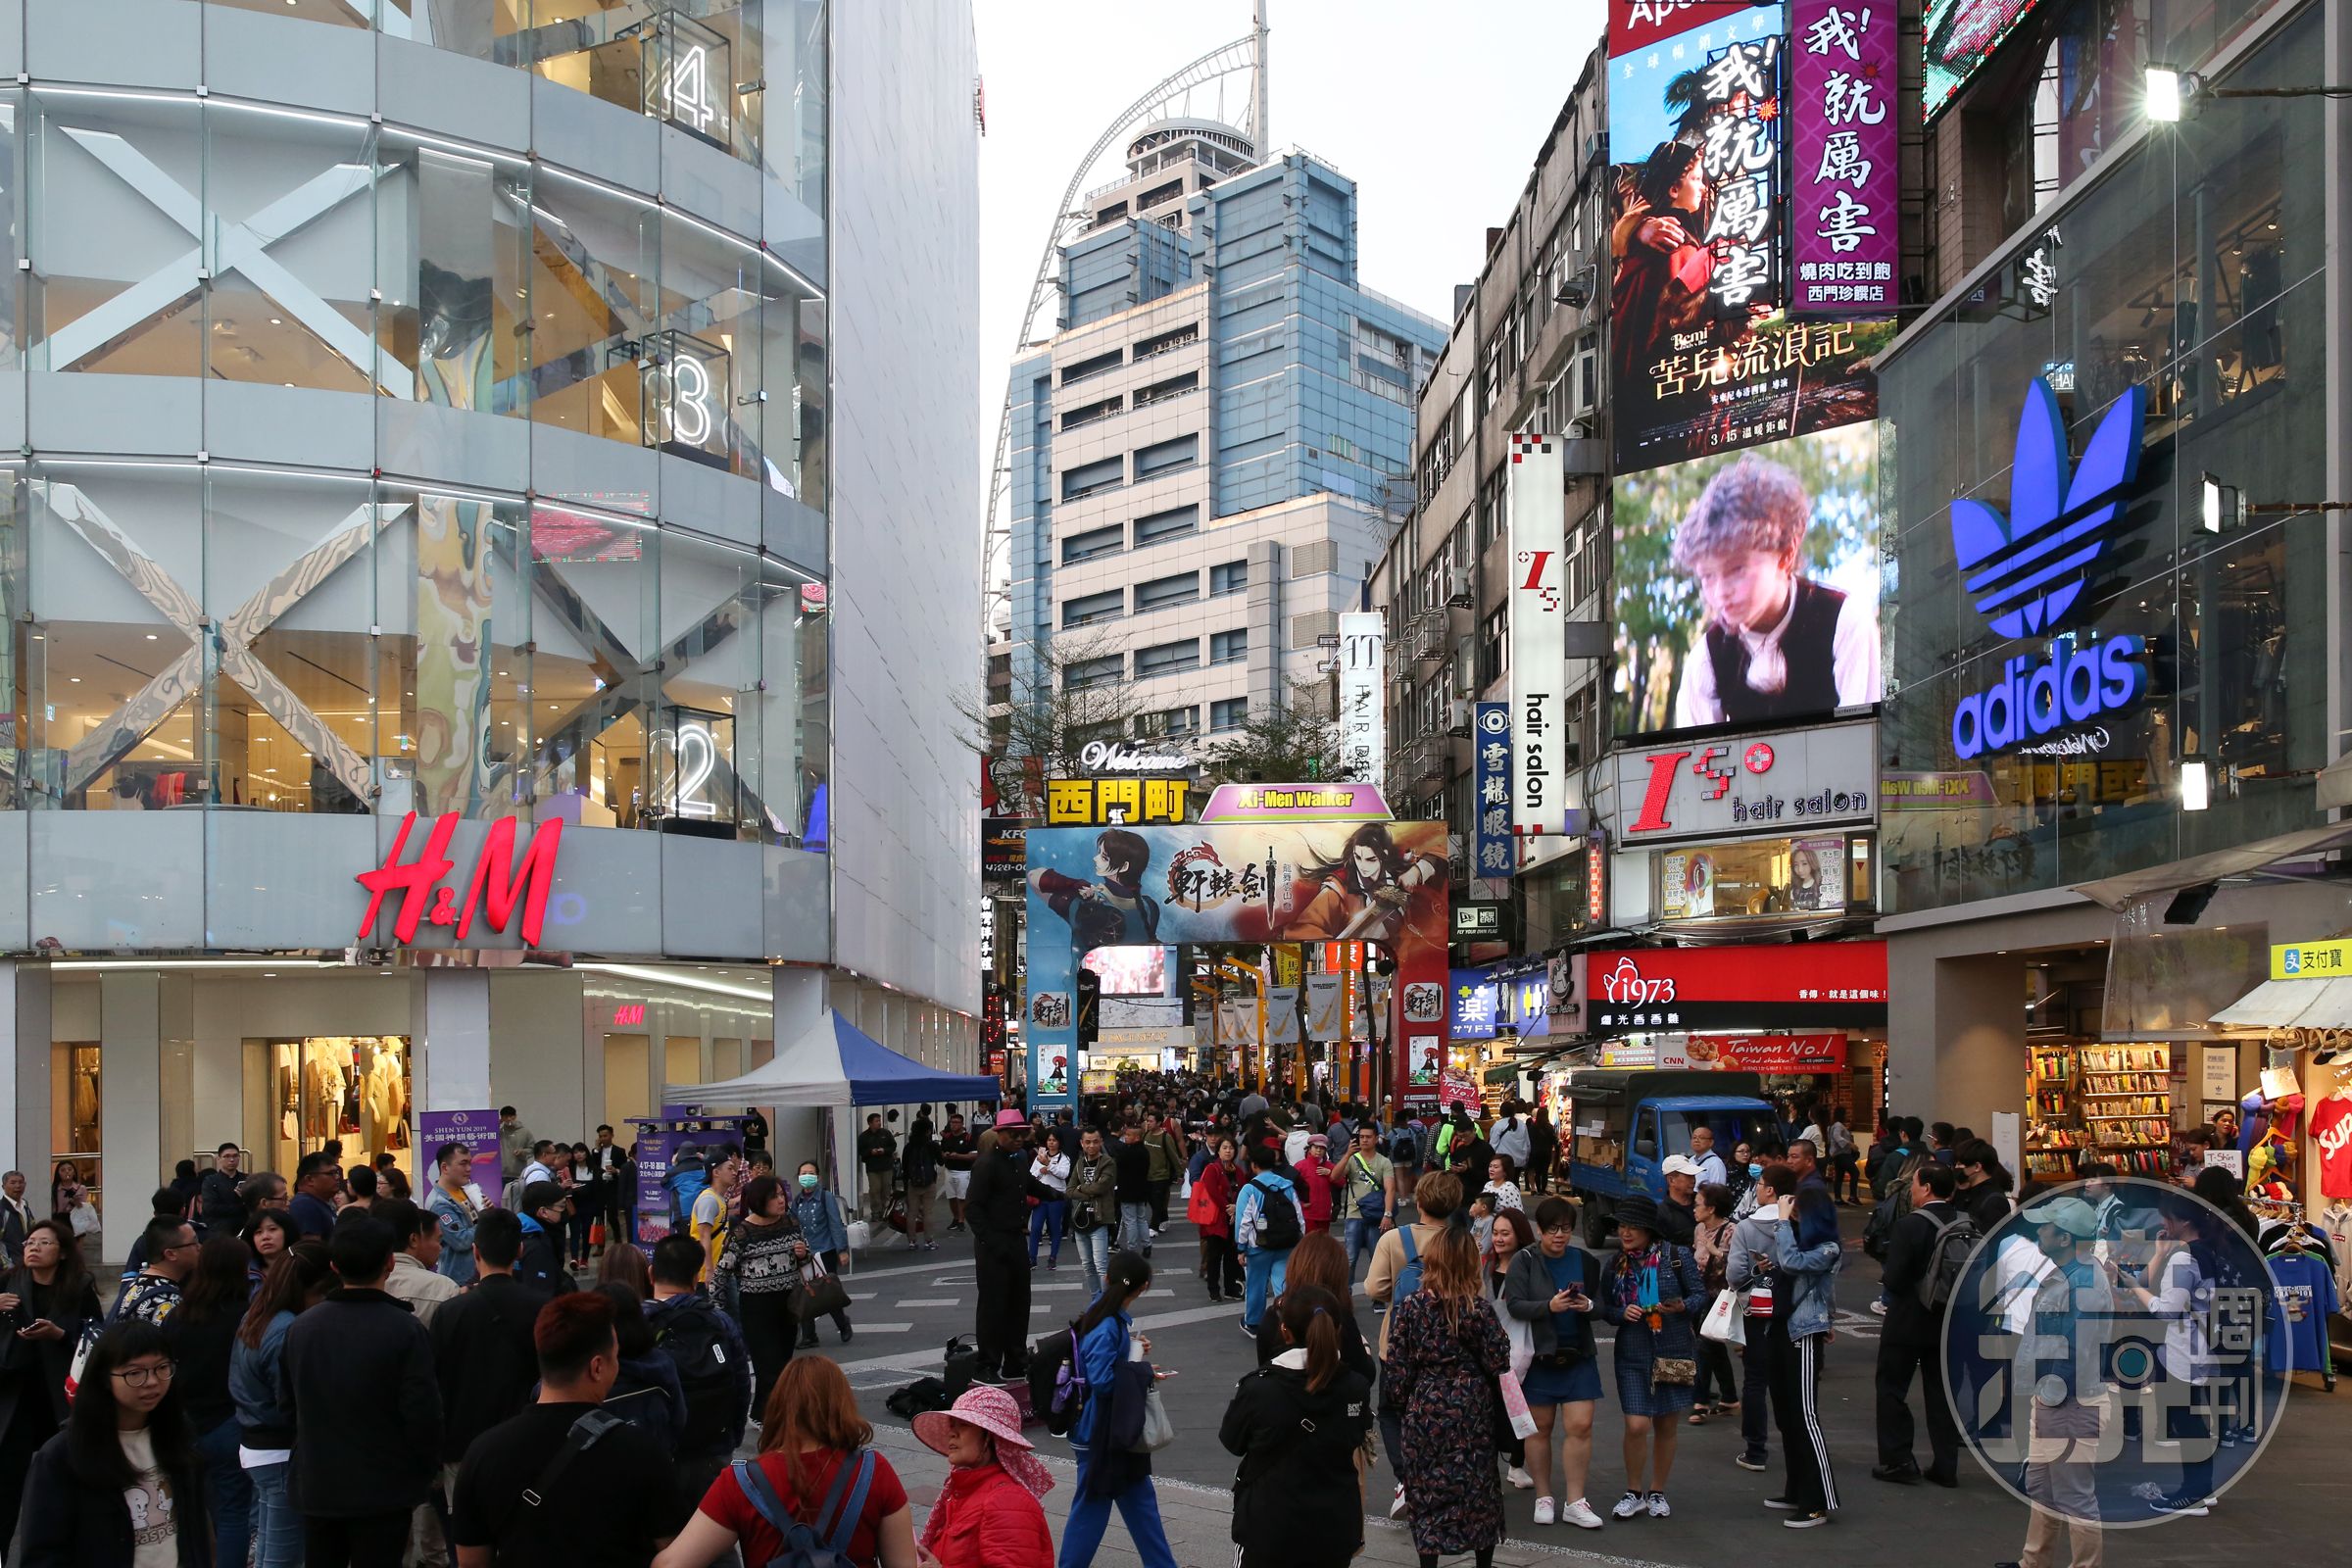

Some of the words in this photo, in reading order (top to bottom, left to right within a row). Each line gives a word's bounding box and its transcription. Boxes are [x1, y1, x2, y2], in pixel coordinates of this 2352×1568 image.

[663, 45, 714, 134] 4
[1799, 262, 1891, 282] 燒肉吃到飽
[1649, 322, 1855, 400] 苦兒流浪記
[665, 354, 711, 446] 3
[1526, 693, 1549, 738] hair
[1952, 635, 2144, 760] adidas
[670, 723, 716, 815] 2
[1080, 739, 1190, 771] Welcome
[1526, 743, 1549, 808] salon
[1049, 779, 1190, 824] 西門町
[1238, 790, 1295, 808] Xi-Men
[1296, 790, 1353, 808] Walker
[1480, 742, 1510, 870] 雪龍眼鏡
[1733, 795, 1784, 822] hair
[1794, 788, 1867, 815] salon
[354, 810, 564, 947] H&M
[2303, 949, 2342, 969] 支付寶
[1621, 977, 1676, 1009] 1973
[1453, 1024, 1494, 1033] サツドラ
[1727, 1038, 1783, 1054] Taiwan
[1787, 1036, 1833, 1055] No.1
[1663, 1056, 1685, 1065] CNN
